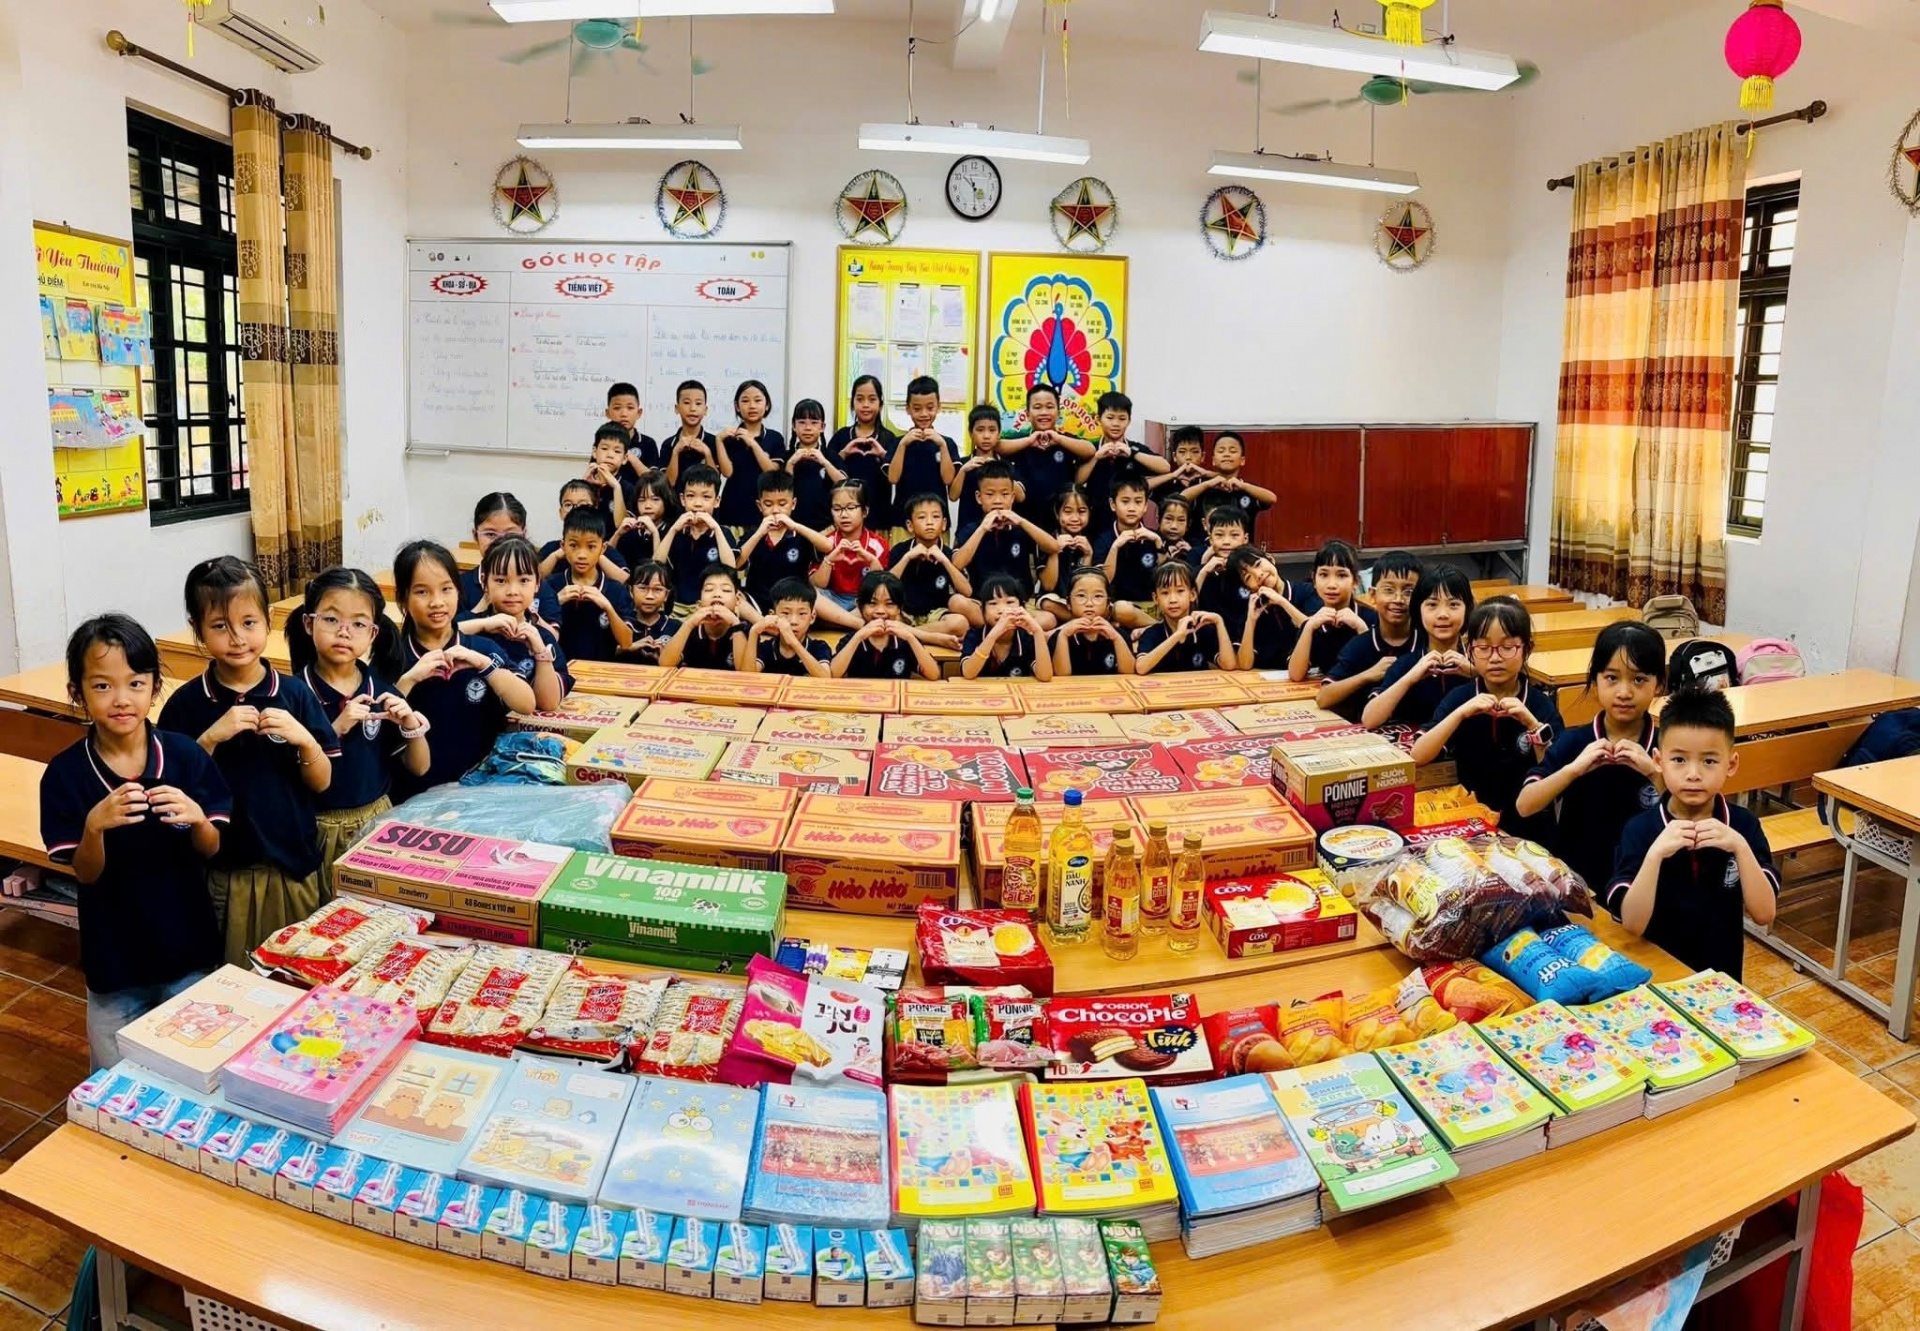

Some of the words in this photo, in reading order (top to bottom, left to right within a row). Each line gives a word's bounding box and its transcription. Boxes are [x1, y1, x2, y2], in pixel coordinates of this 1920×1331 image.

[46, 248, 72, 268] Yêu
[522, 252, 567, 269] GÓC
[574, 252, 616, 268] HỌC
[624, 254, 661, 271] TẬP
[568, 281, 587, 293] TIẾNG
[588, 282, 602, 293] VIỆT
[717, 285, 736, 296] TOÁN
[664, 717, 735, 730] KOKOMI
[771, 730, 866, 743] KOKOMI
[1031, 728, 1099, 737] KOKOMI
[896, 735, 994, 745] KOKOMI
[1048, 749, 1152, 762] KOKOMI
[975, 751, 1012, 794] KOKOMI
[635, 815, 676, 827] Hảo
[677, 817, 719, 829] Hảo
[377, 825, 475, 856] SUSU
[804, 831, 846, 843] Hảo
[849, 831, 892, 844] Hảo
[340, 873, 373, 889] Vinamilk
[584, 857, 766, 895] Vinamilk
[398, 886, 429, 900] Strawberry
[827, 877, 867, 900] Hảo
[869, 876, 909, 899] Hảo
[1214, 885, 1254, 895] COSY
[473, 899, 492, 910] Boxes
[628, 922, 677, 939] Vinamilk
[1249, 932, 1270, 941] COSY
[1103, 1002, 1149, 1010] ORION
[1058, 1007, 1187, 1023] ChocoPie
